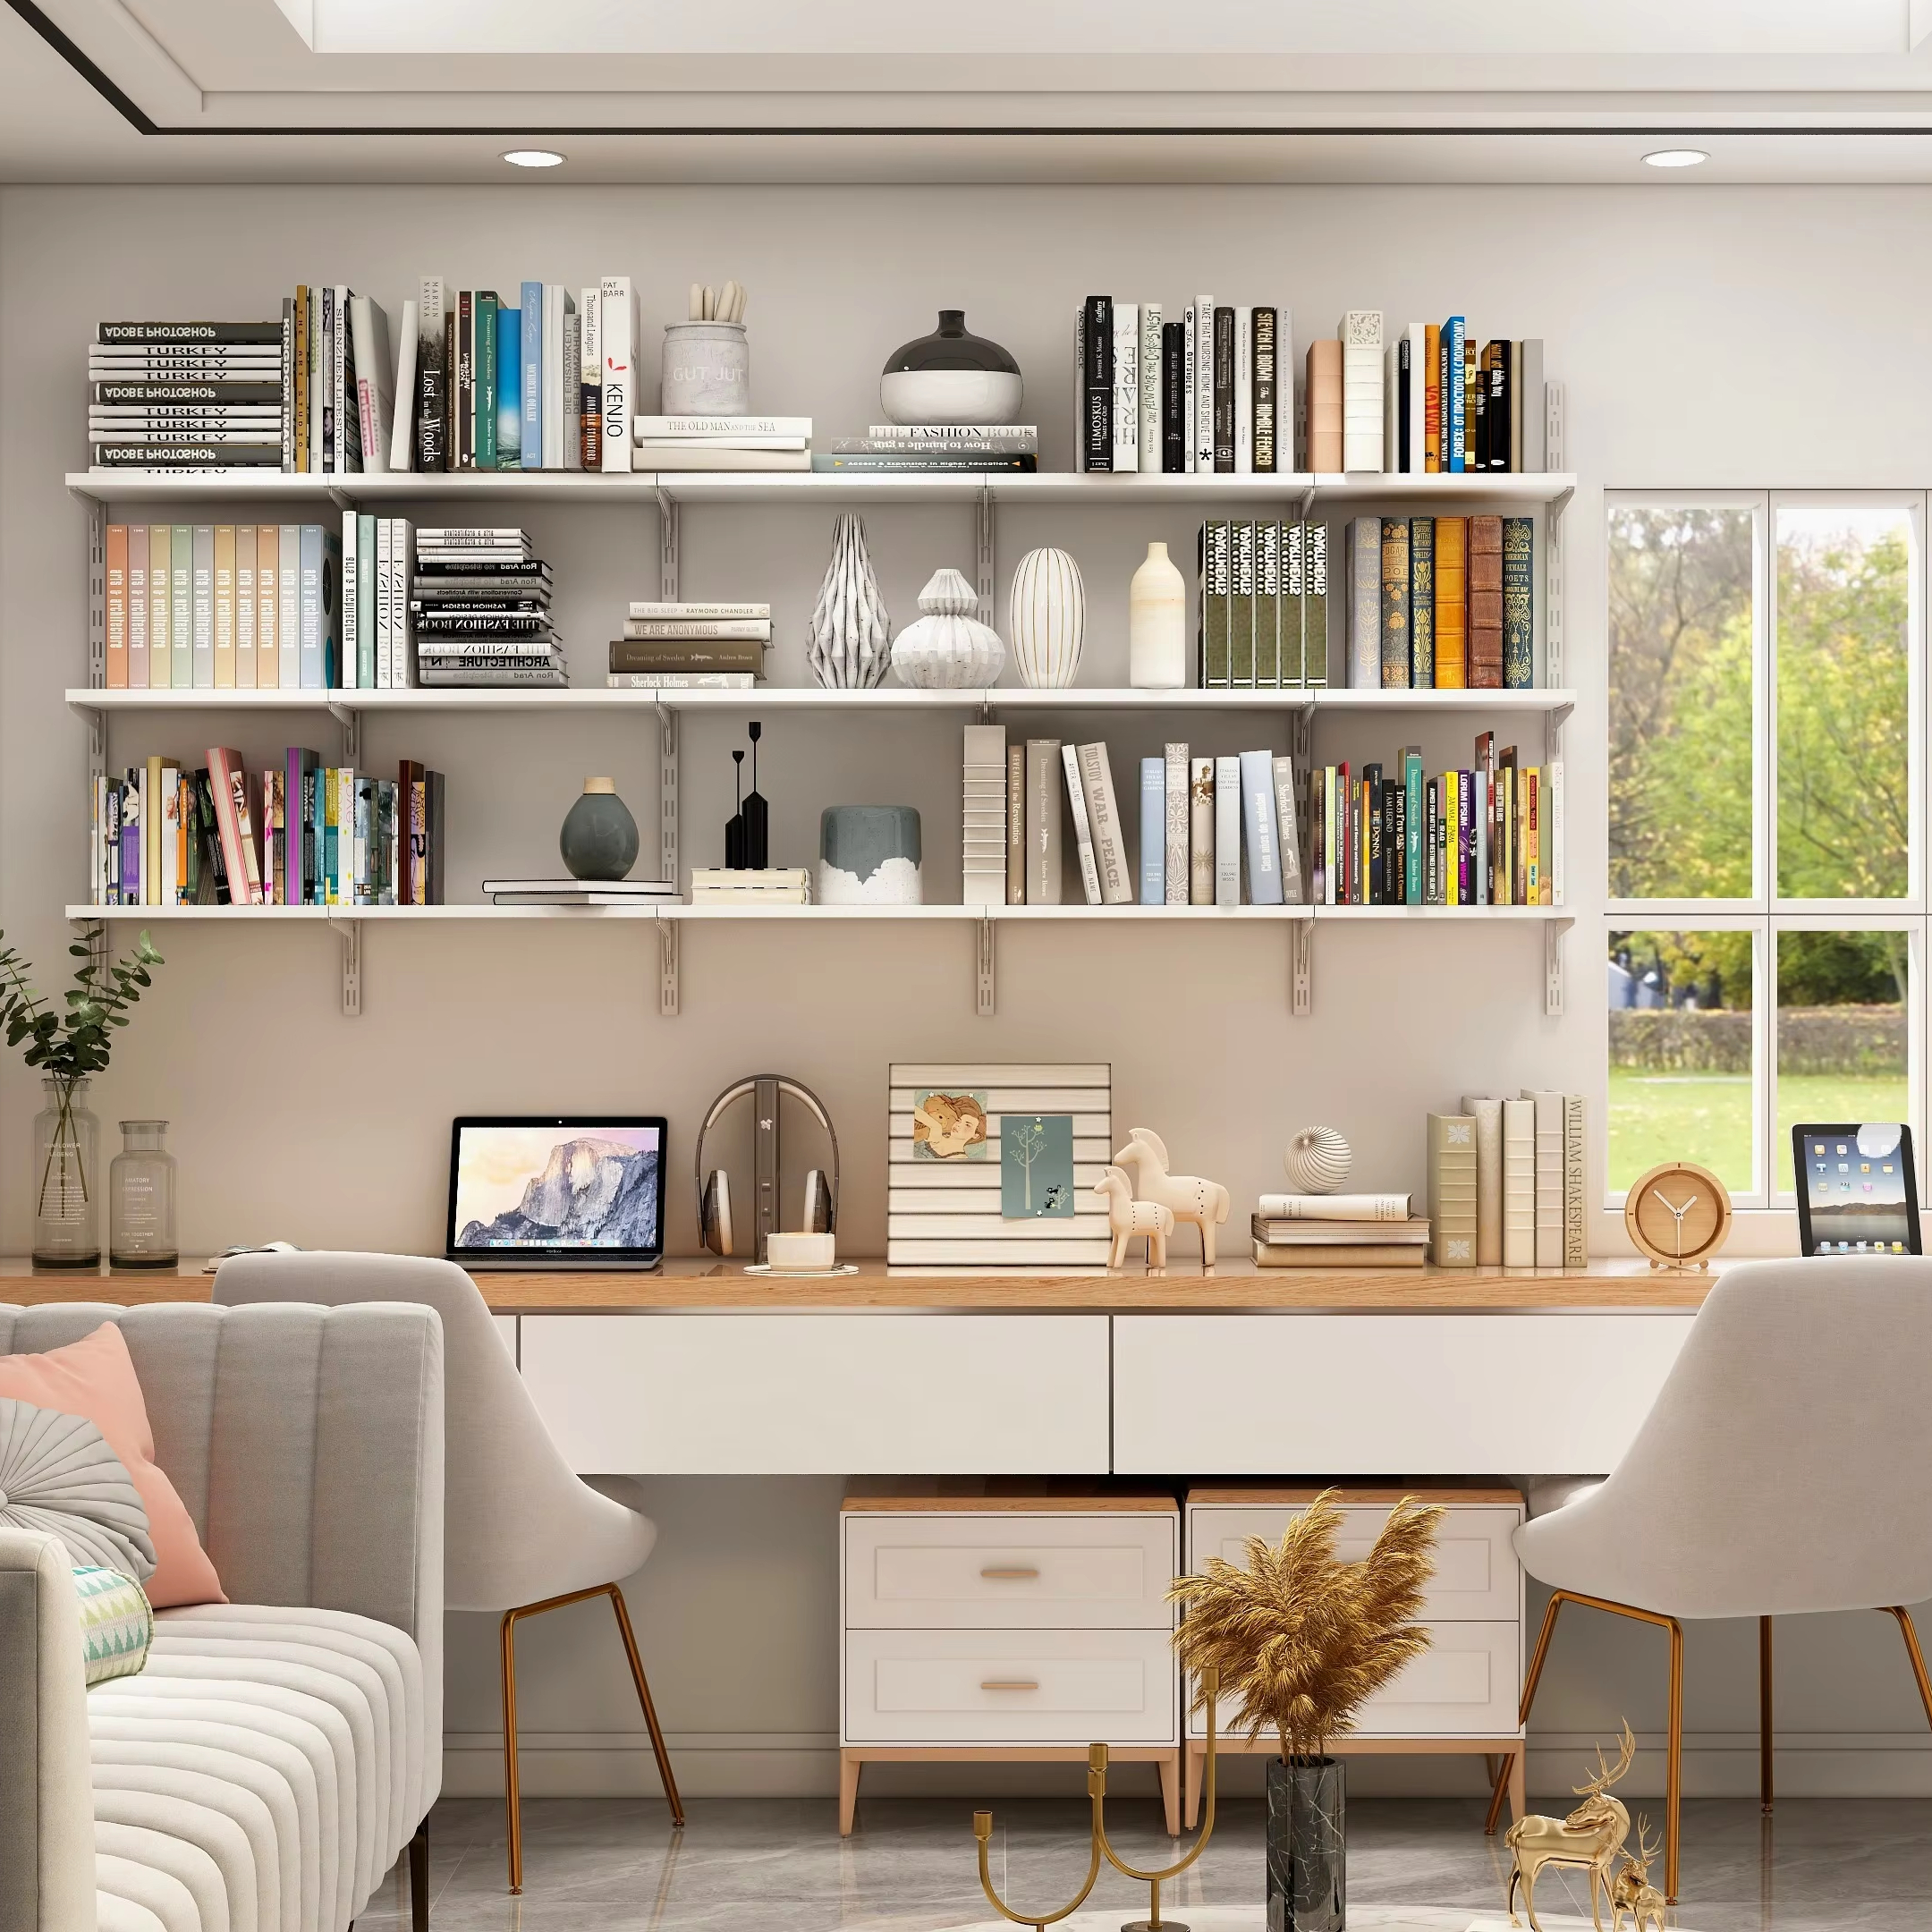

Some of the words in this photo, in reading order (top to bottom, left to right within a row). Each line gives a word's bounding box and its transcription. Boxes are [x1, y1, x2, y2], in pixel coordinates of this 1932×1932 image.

[587, 295, 596, 327] Thousand
[1201, 303, 1211, 319] TAKE
[1201, 321, 1211, 339] THAT
[1257, 313, 1273, 343] STEVEN
[585, 329, 596, 356] Leagues
[1201, 340, 1211, 371] NURSING
[1453, 321, 1465, 366] СЛОЖНОМУ
[673, 367, 709, 381] GUT
[715, 368, 743, 382] JUT
[1257, 354, 1273, 381] BROWN
[423, 369, 440, 398] Lost
[1201, 373, 1211, 392] HOME
[1260, 386, 1269, 399] The
[1453, 376, 1465, 414] ПРОСТОГО
[587, 396, 596, 426] JONATHAN
[607, 384, 623, 437] KENJO
[1201, 395, 1211, 409] AND
[667, 421, 686, 430] THE
[688, 421, 708, 430] OLD
[710, 421, 730, 430] MAN
[758, 422, 775, 432] SEA
[871, 428, 905, 437] THE
[910, 428, 982, 437] FASHION
[987, 428, 1034, 437] BOOK
[1092, 396, 1102, 451] ILIMOSKUS
[1201, 411, 1211, 433] SHOVE
[1256, 404, 1273, 434] HUMBLE
[1453, 415, 1465, 425] ОТ
[423, 418, 440, 462] Woods
[587, 428, 596, 461] STANDFORD
[898, 441, 904, 449] a
[907, 440, 947, 450] handle
[949, 441, 962, 450] to
[973, 441, 991, 450] How
[1201, 435, 1211, 444] IT!
[1256, 436, 1273, 466] FENCER
[1453, 428, 1465, 458] FOREX:
[110, 569, 123, 585] arts
[131, 569, 145, 585] arts
[174, 569, 188, 585] arts
[217, 569, 231, 585] arts
[261, 569, 274, 585] arts
[304, 569, 318, 585] arts
[110, 599, 125, 648] architecture
[131, 599, 146, 648] architecture
[174, 599, 190, 648] architecture
[217, 599, 233, 648] architecture
[261, 599, 276, 648] architecture
[304, 599, 319, 648] architecture
[635, 625, 647, 635] WE
[649, 625, 665, 635] ARE
[667, 625, 718, 635] ANONYMOUS
[631, 676, 661, 688] Sherlock
[663, 676, 689, 688] Holmes
[1012, 754, 1020, 791] REVEALING
[1084, 746, 1103, 781] TOLSTOY
[1410, 769, 1418, 797] Dreaming
[1460, 774, 1468, 801] LORUM
[1092, 786, 1109, 825] WAR
[1254, 793, 1269, 822] soledad
[1279, 784, 1289, 814] Sherlock
[1448, 796, 1457, 822] ANIMAL
[1013, 803, 1021, 845] Revolution
[1280, 815, 1292, 840] Holmes
[1373, 809, 1381, 825] THE
[1460, 802, 1468, 826] IPSUM
[1259, 824, 1271, 835] de
[1372, 826, 1381, 859] DONNA
[1448, 825, 1457, 843] FARM
[1260, 835, 1271, 853] años
[1084, 854, 1093, 875] AUTHOR
[1101, 838, 1120, 888] PEACE
[1261, 854, 1271, 872] Cien
[1088, 878, 1096, 893] NAME
[1569, 1100, 1582, 1163] WILLIAM
[1569, 1167, 1582, 1263] SHAKESPEARE
